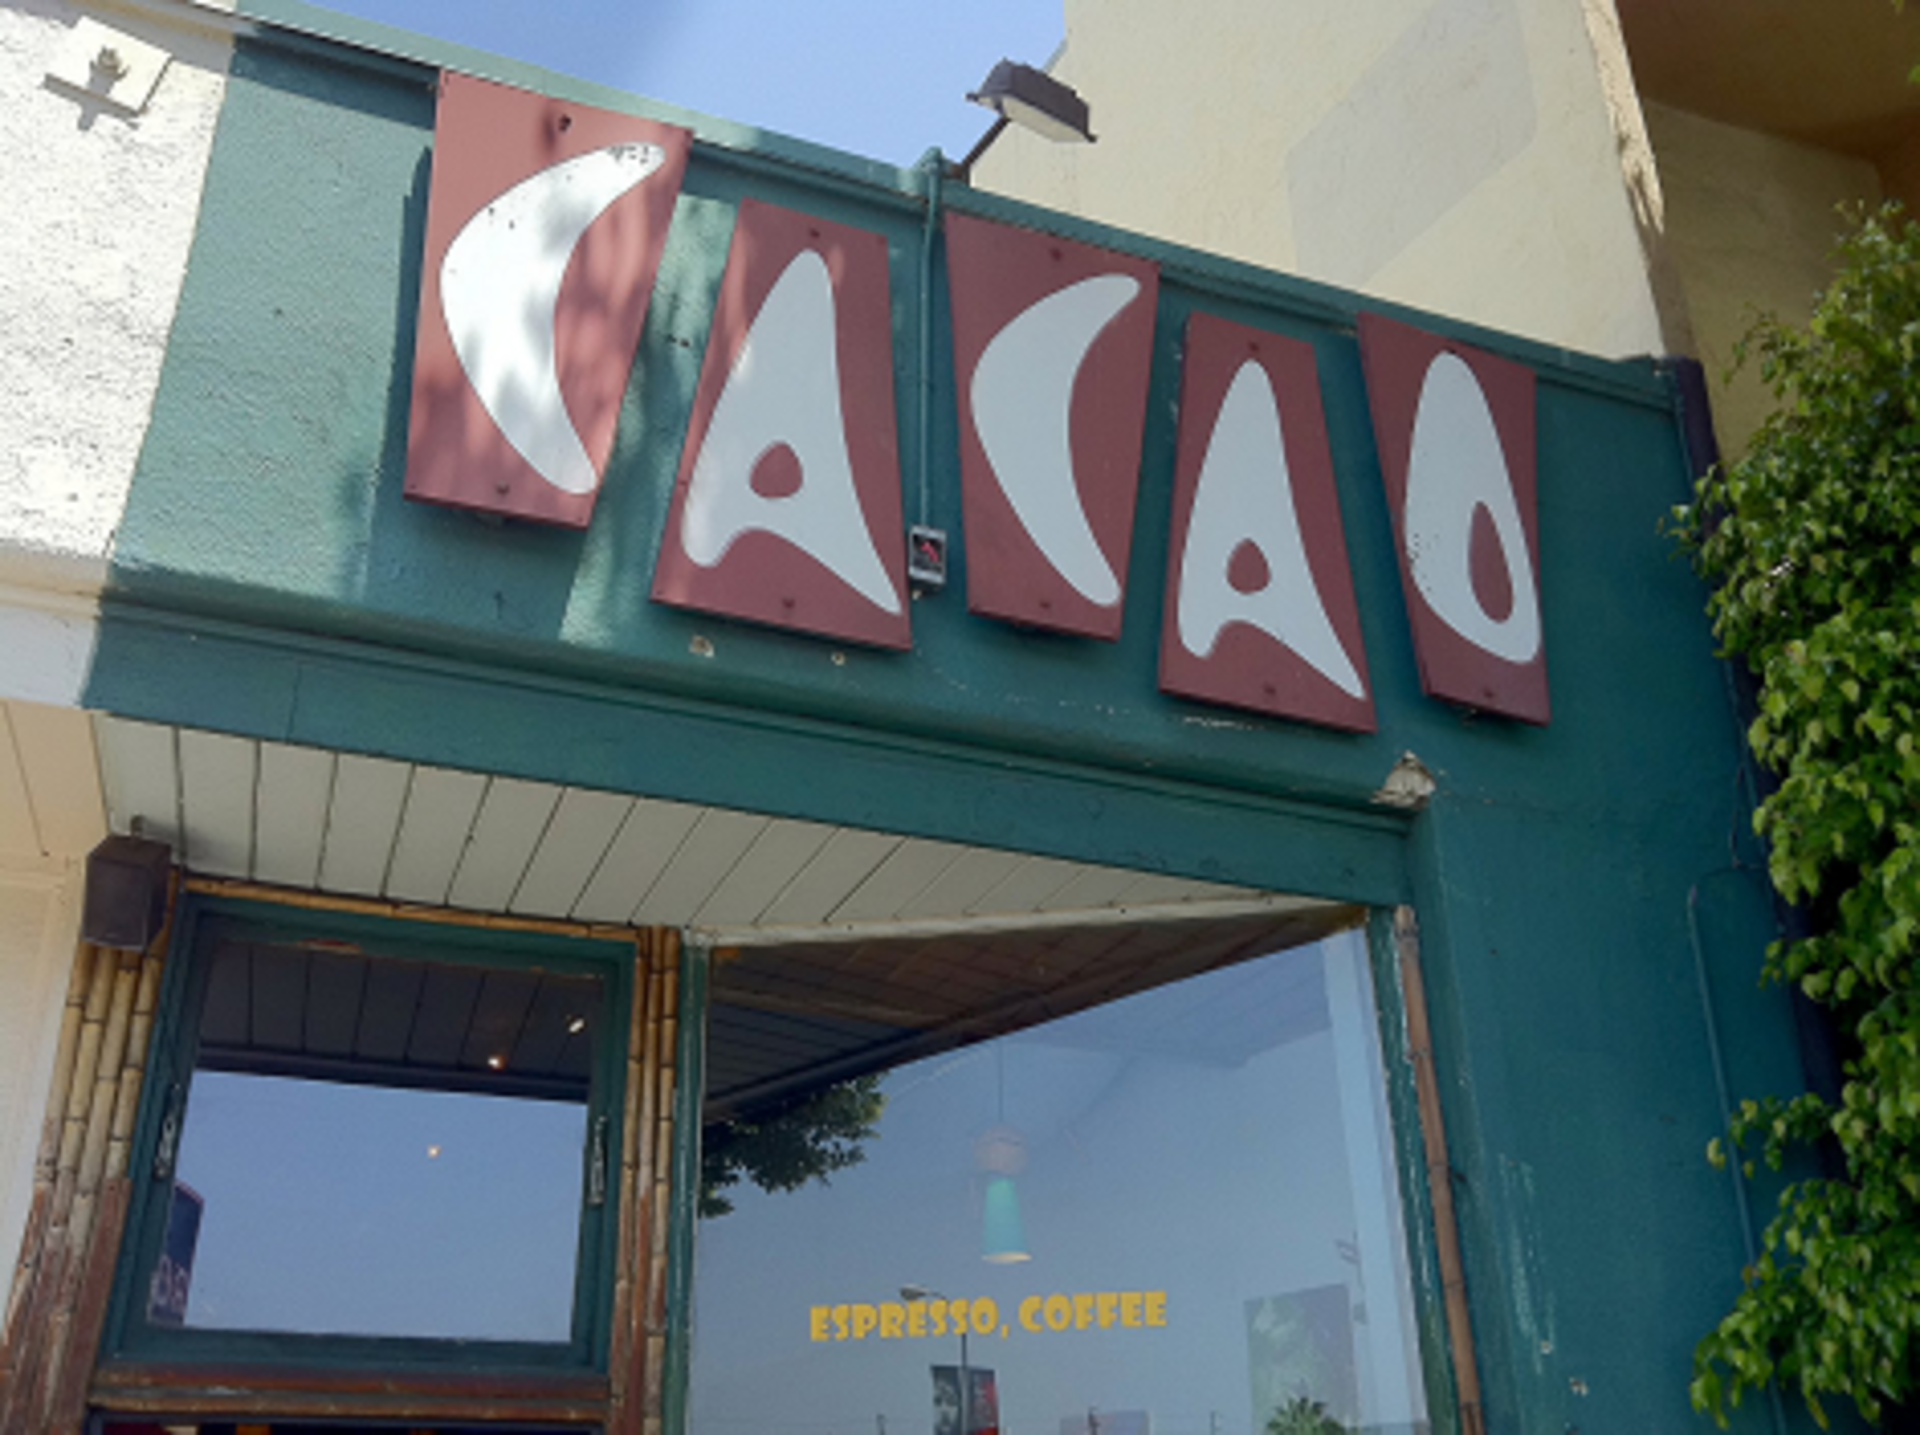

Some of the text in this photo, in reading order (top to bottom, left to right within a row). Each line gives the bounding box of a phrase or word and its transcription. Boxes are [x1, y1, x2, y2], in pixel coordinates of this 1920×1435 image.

[440, 143, 1542, 701] CACAO
[809, 1291, 1167, 1341] ESPRESSO, COFFEE
